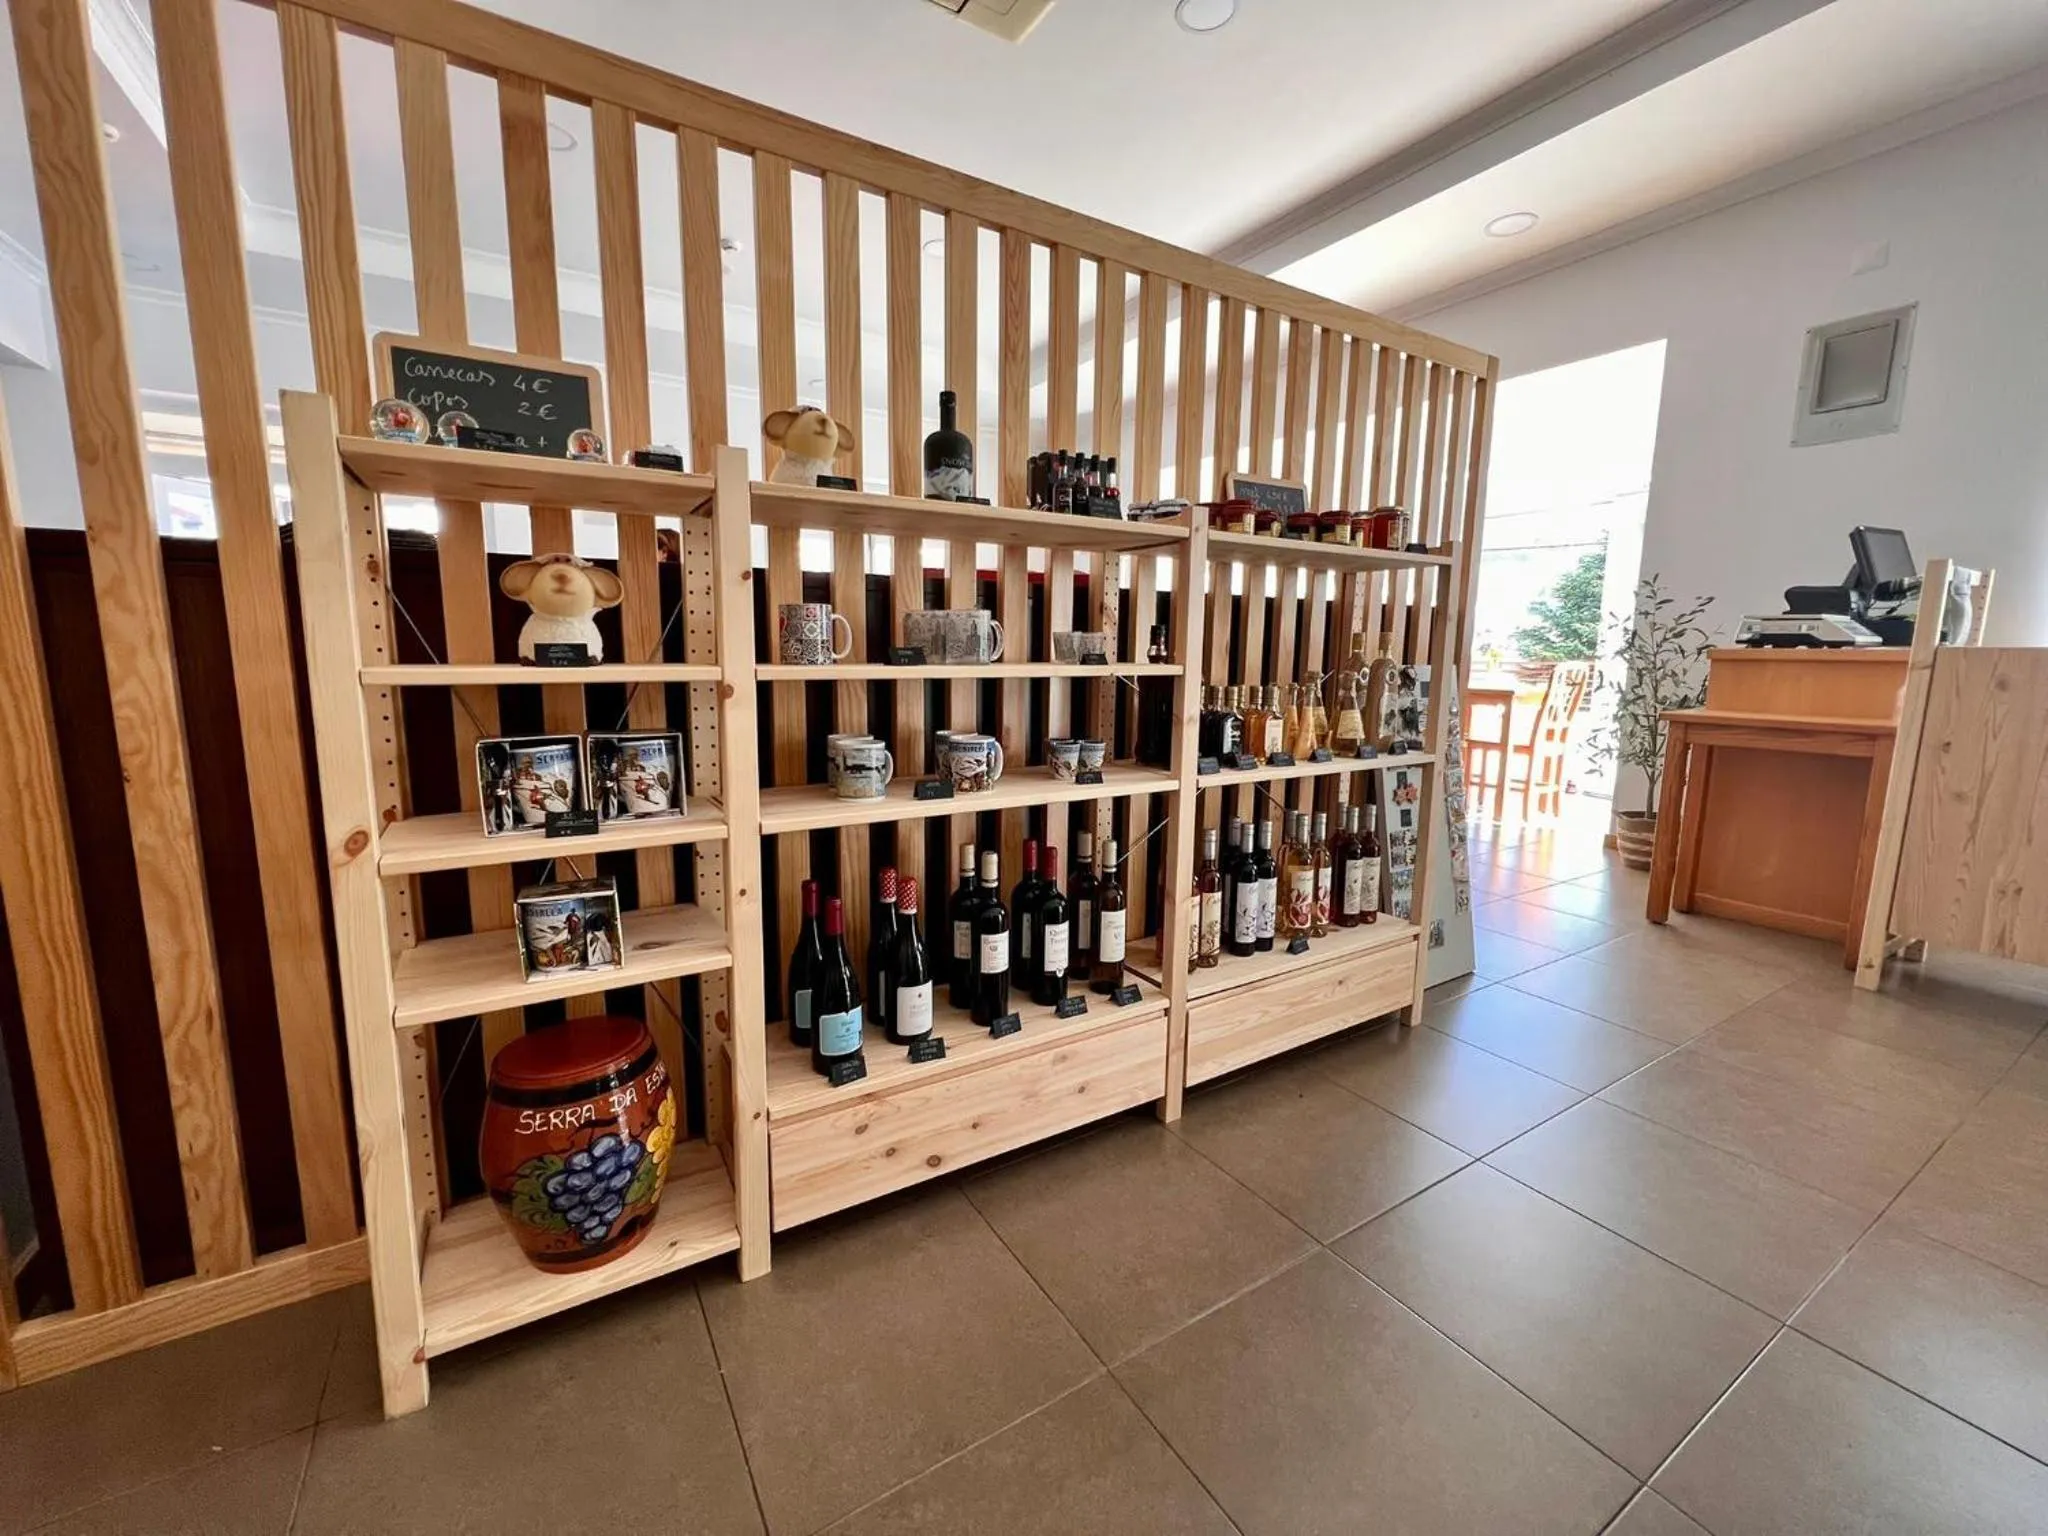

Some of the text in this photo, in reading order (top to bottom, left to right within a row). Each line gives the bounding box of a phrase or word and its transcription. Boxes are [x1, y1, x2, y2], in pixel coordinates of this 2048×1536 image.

[404, 356, 496, 387] Canecas
[407, 387, 469, 412] Copos
[514, 1103, 596, 1135] SERRA
[608, 1087, 638, 1113] DA
